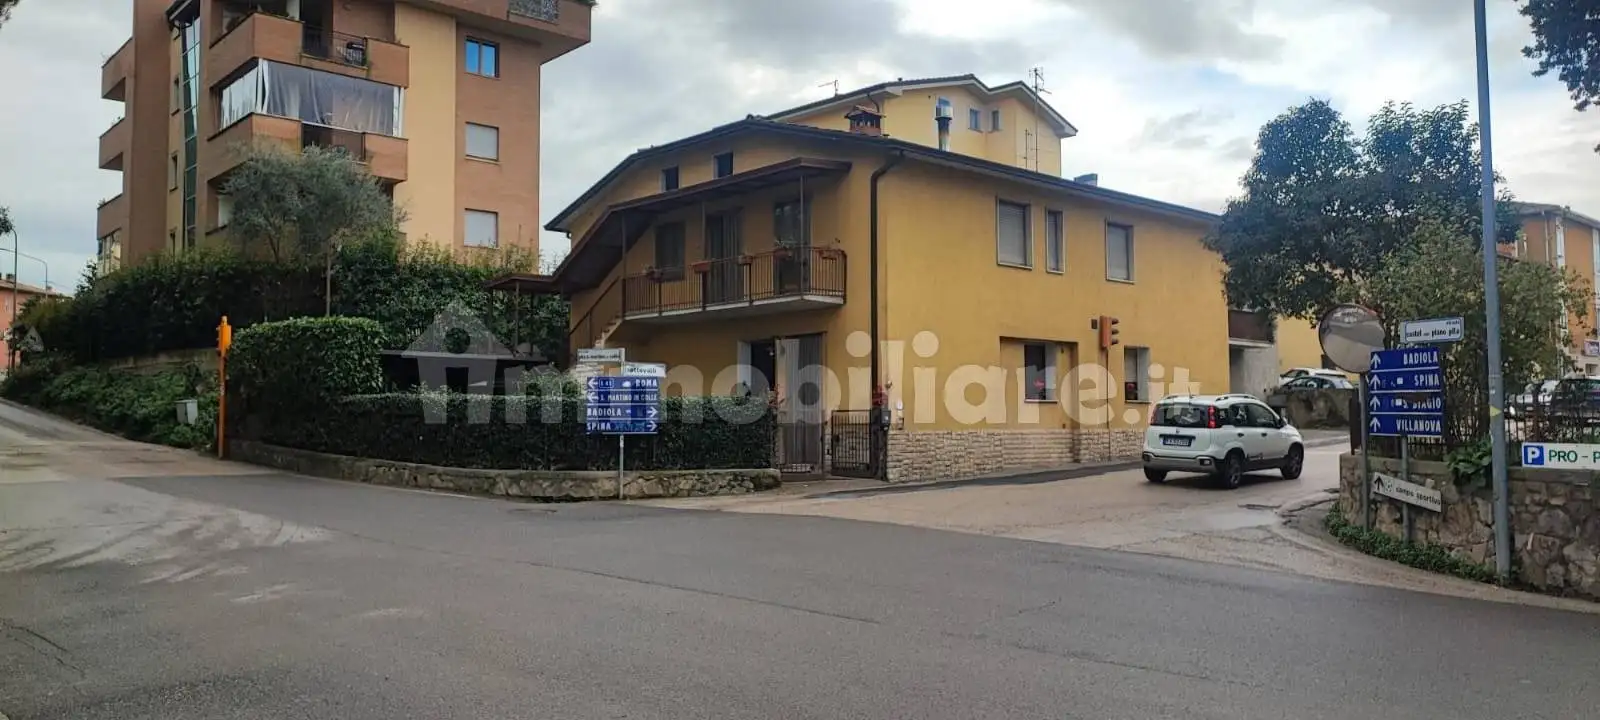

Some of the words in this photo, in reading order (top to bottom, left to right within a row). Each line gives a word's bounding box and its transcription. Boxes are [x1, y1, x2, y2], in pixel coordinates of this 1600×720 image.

[1431, 328, 1447, 337] piano
[1403, 351, 1438, 365] BADIOLA
[635, 379, 658, 388] ROMA
[1414, 374, 1440, 386] SPINA
[586, 422, 611, 431] SPINA
[1396, 419, 1442, 432] VILLANOVA
[1527, 446, 1541, 464] P
[1548, 449, 1578, 463] PRO
[1395, 487, 1414, 497] campo
[1416, 493, 1441, 505] sportivo
